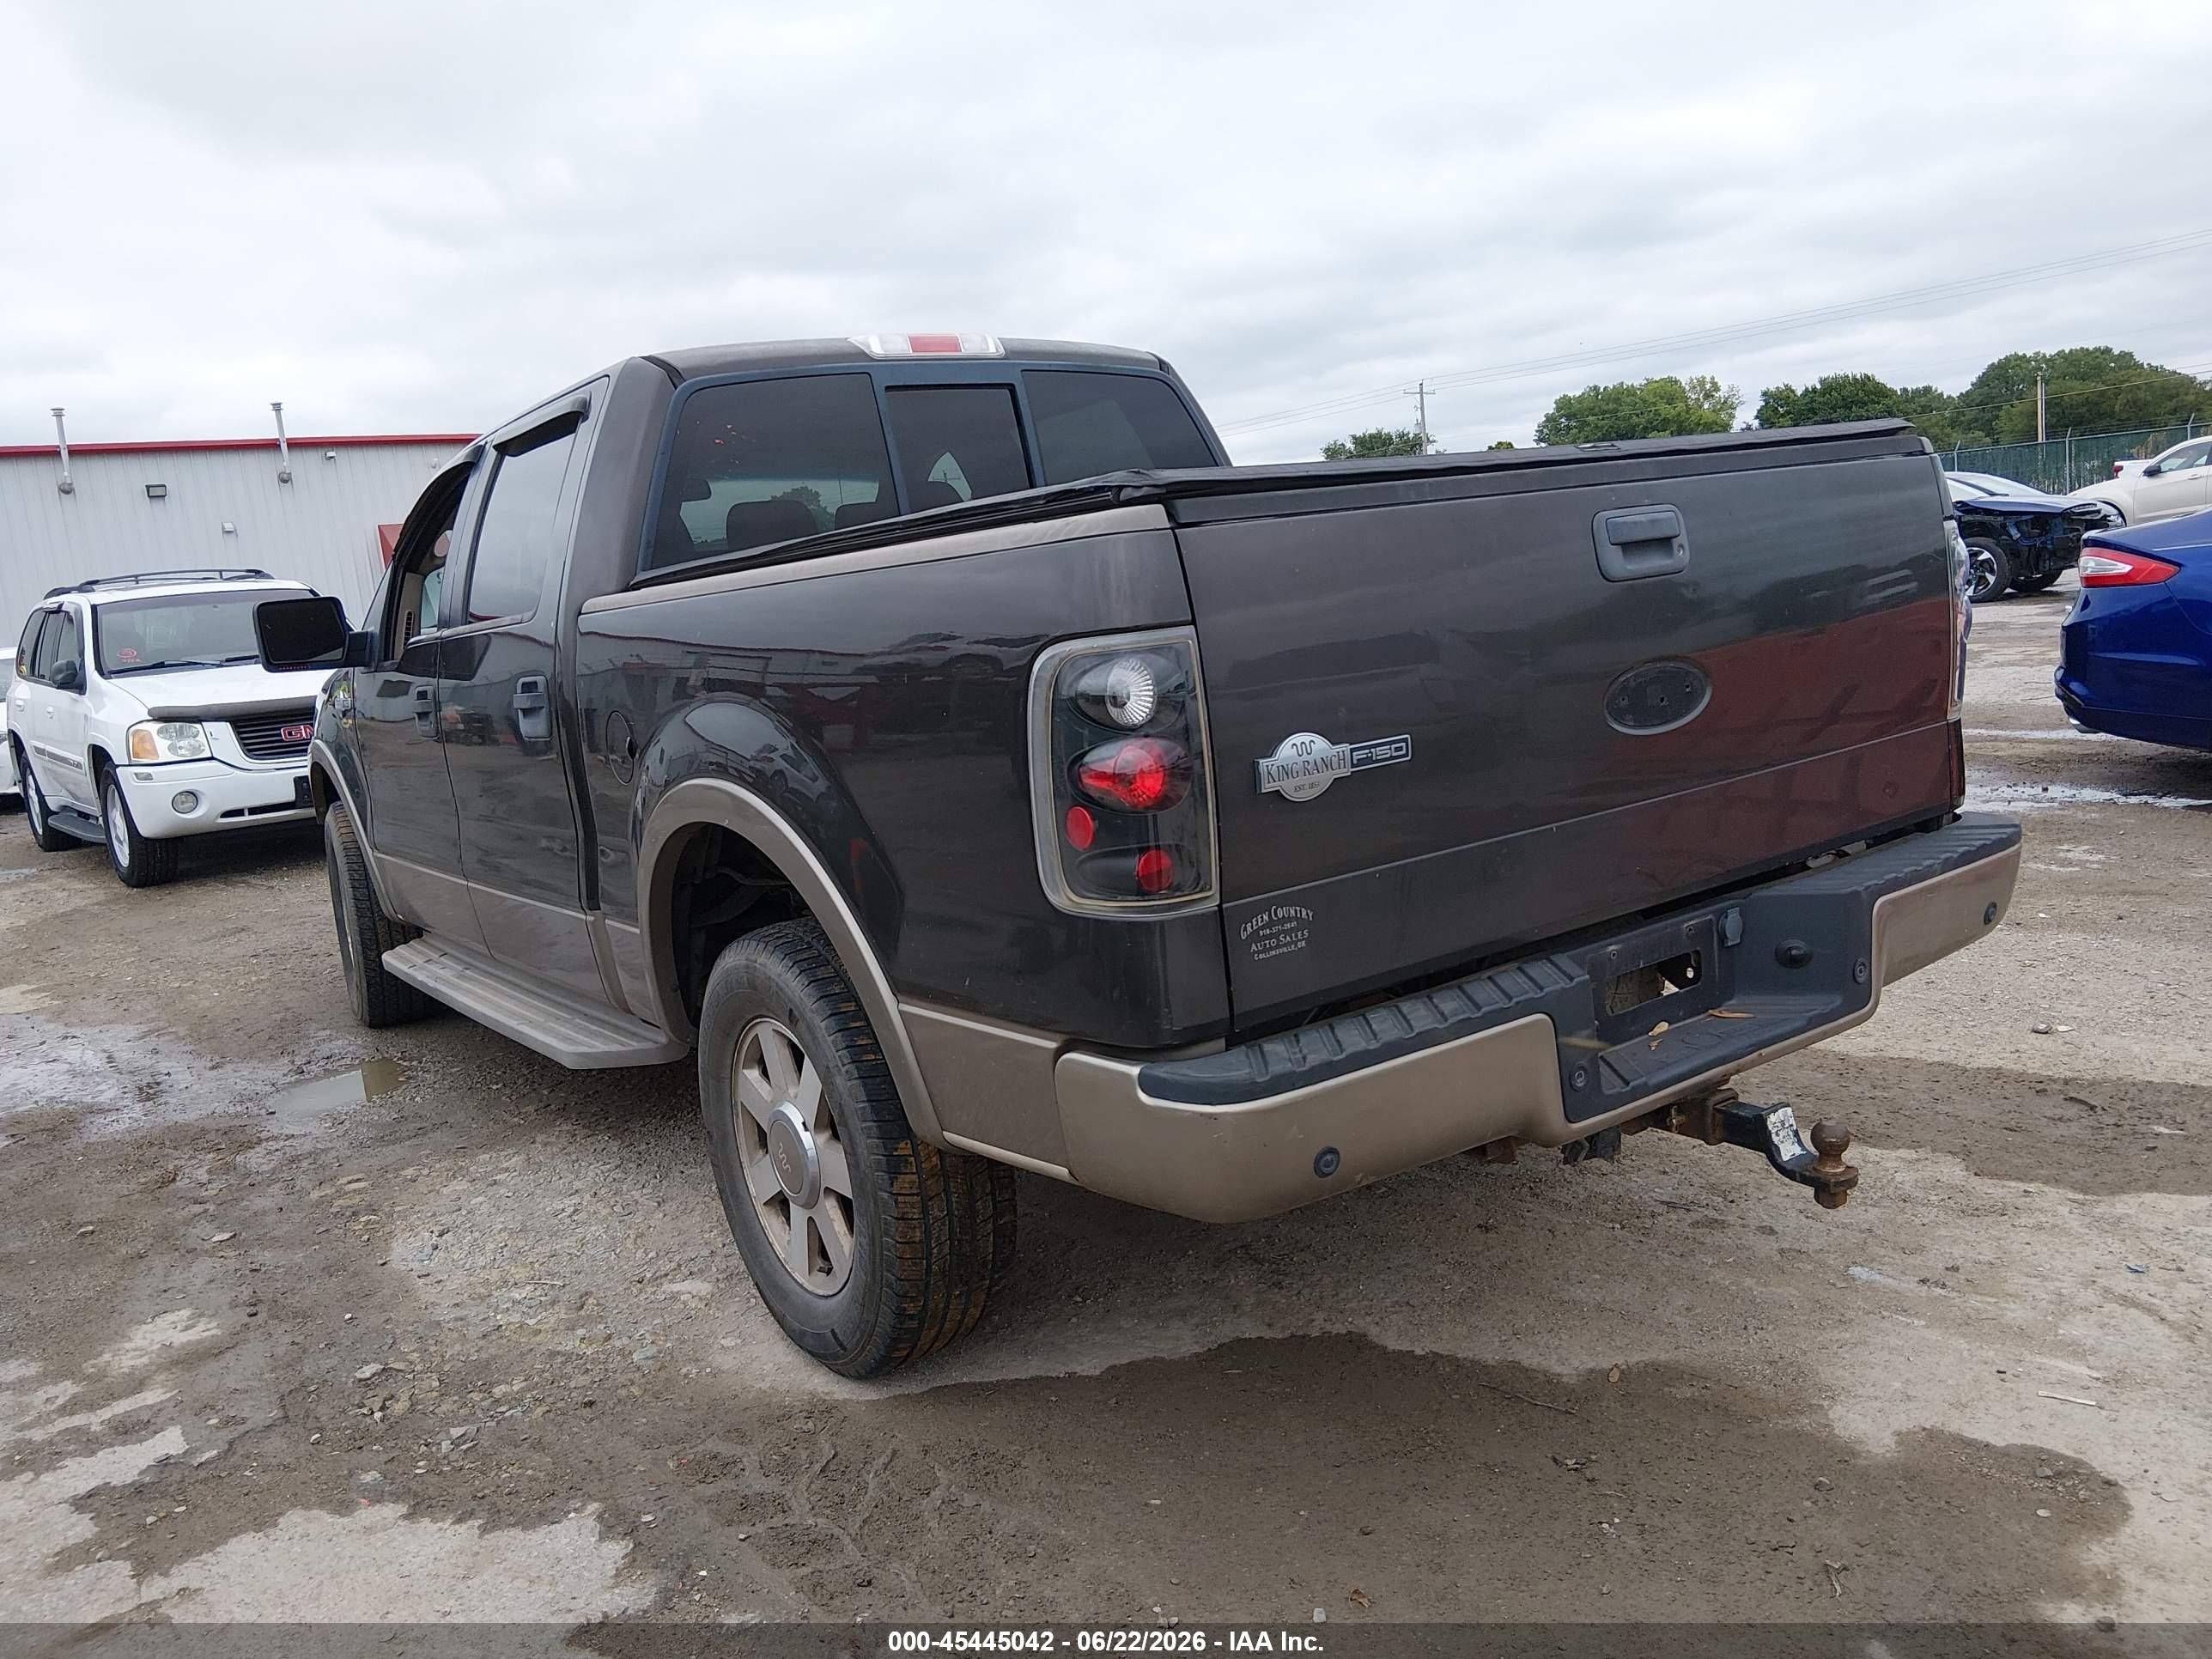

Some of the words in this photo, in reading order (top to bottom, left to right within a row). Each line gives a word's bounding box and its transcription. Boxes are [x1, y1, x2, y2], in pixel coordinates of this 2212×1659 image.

[281, 725, 314, 741] GM
[1266, 763, 1299, 785] KING
[1303, 750, 1346, 776] RANCH
[1240, 912, 1268, 939] GREEN
[1272, 906, 1313, 921] COUNTRY
[1250, 939, 1277, 952] AUTO
[1279, 930, 1309, 945] SALES
